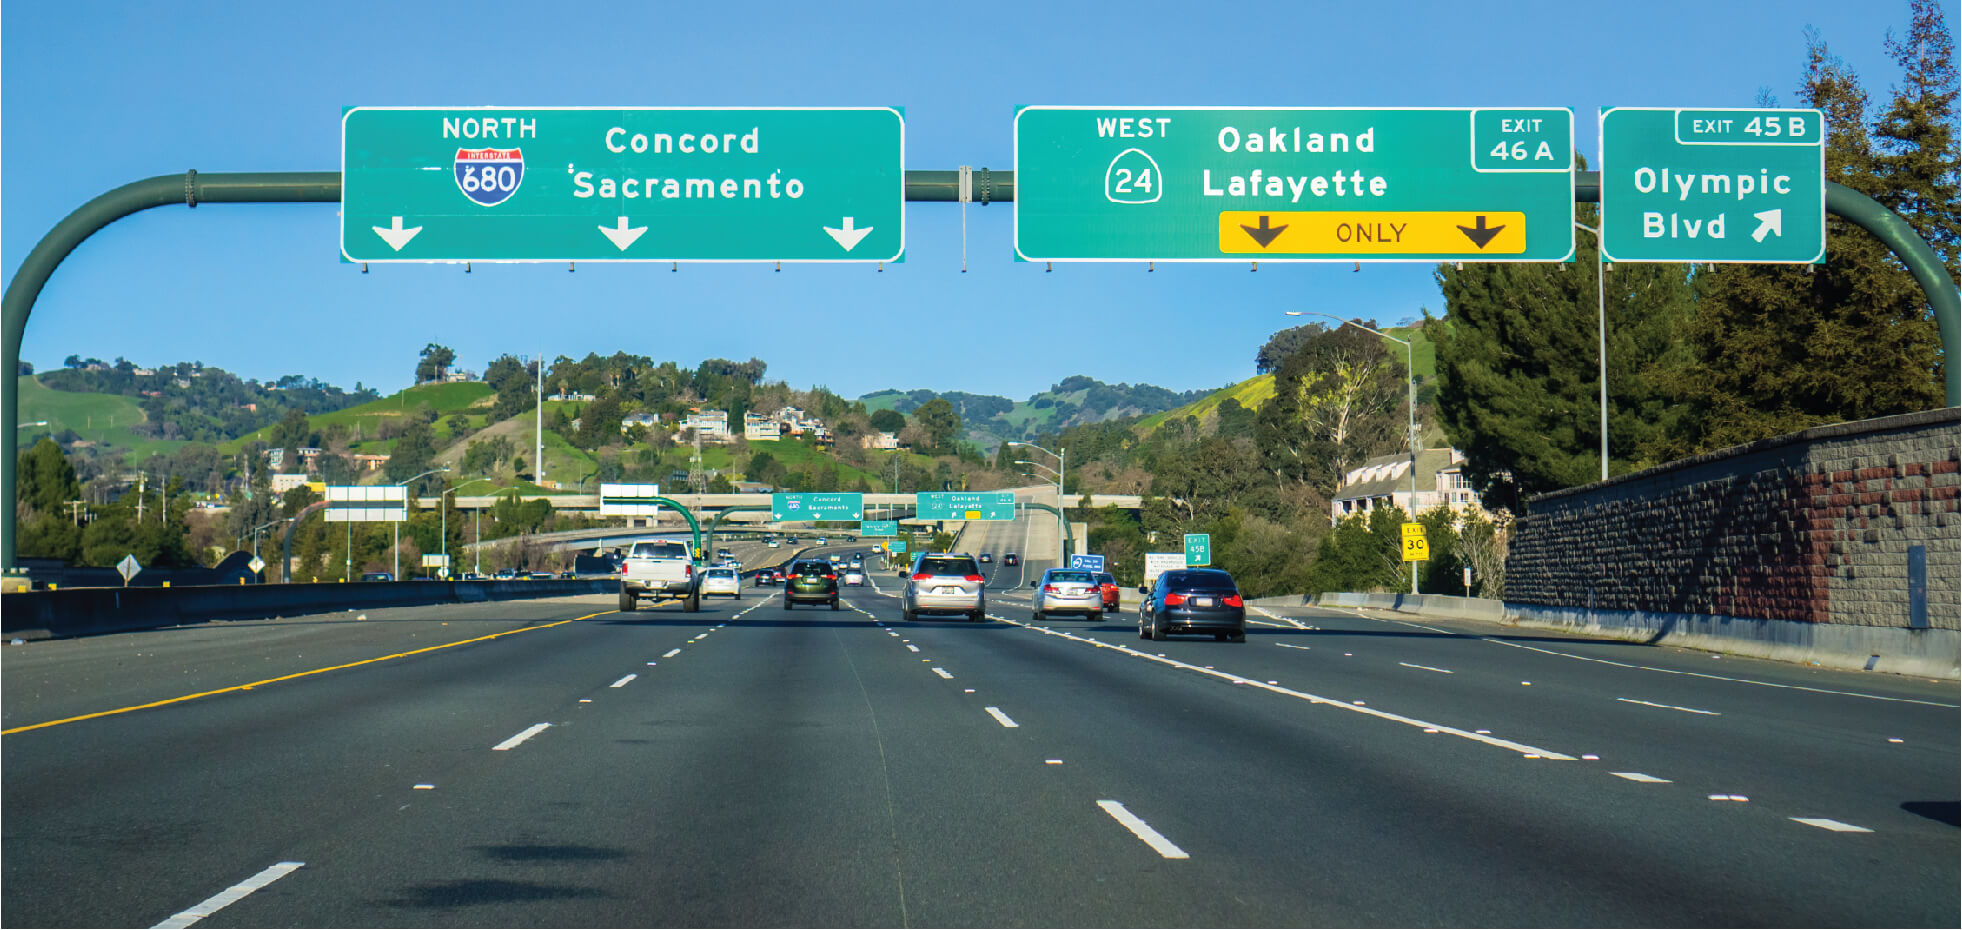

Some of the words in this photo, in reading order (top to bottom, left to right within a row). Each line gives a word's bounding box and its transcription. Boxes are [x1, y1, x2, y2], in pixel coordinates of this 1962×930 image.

[442, 117, 536, 138] NORTH
[1096, 117, 1171, 138] WEST
[1501, 119, 1543, 133] EXIT
[1693, 119, 1733, 134] EXIT
[605, 127, 759, 154] Concord
[1217, 127, 1374, 153] Oakland
[467, 151, 511, 160] INTERSTATE
[462, 165, 516, 192] 680
[572, 169, 804, 199] Sacramento
[1115, 168, 1152, 194] 24
[1203, 168, 1388, 203] Lafayette
[1634, 167, 1791, 201] Olympic
[1336, 223, 1407, 243] ONLY
[1643, 212, 1725, 239] Blvd
